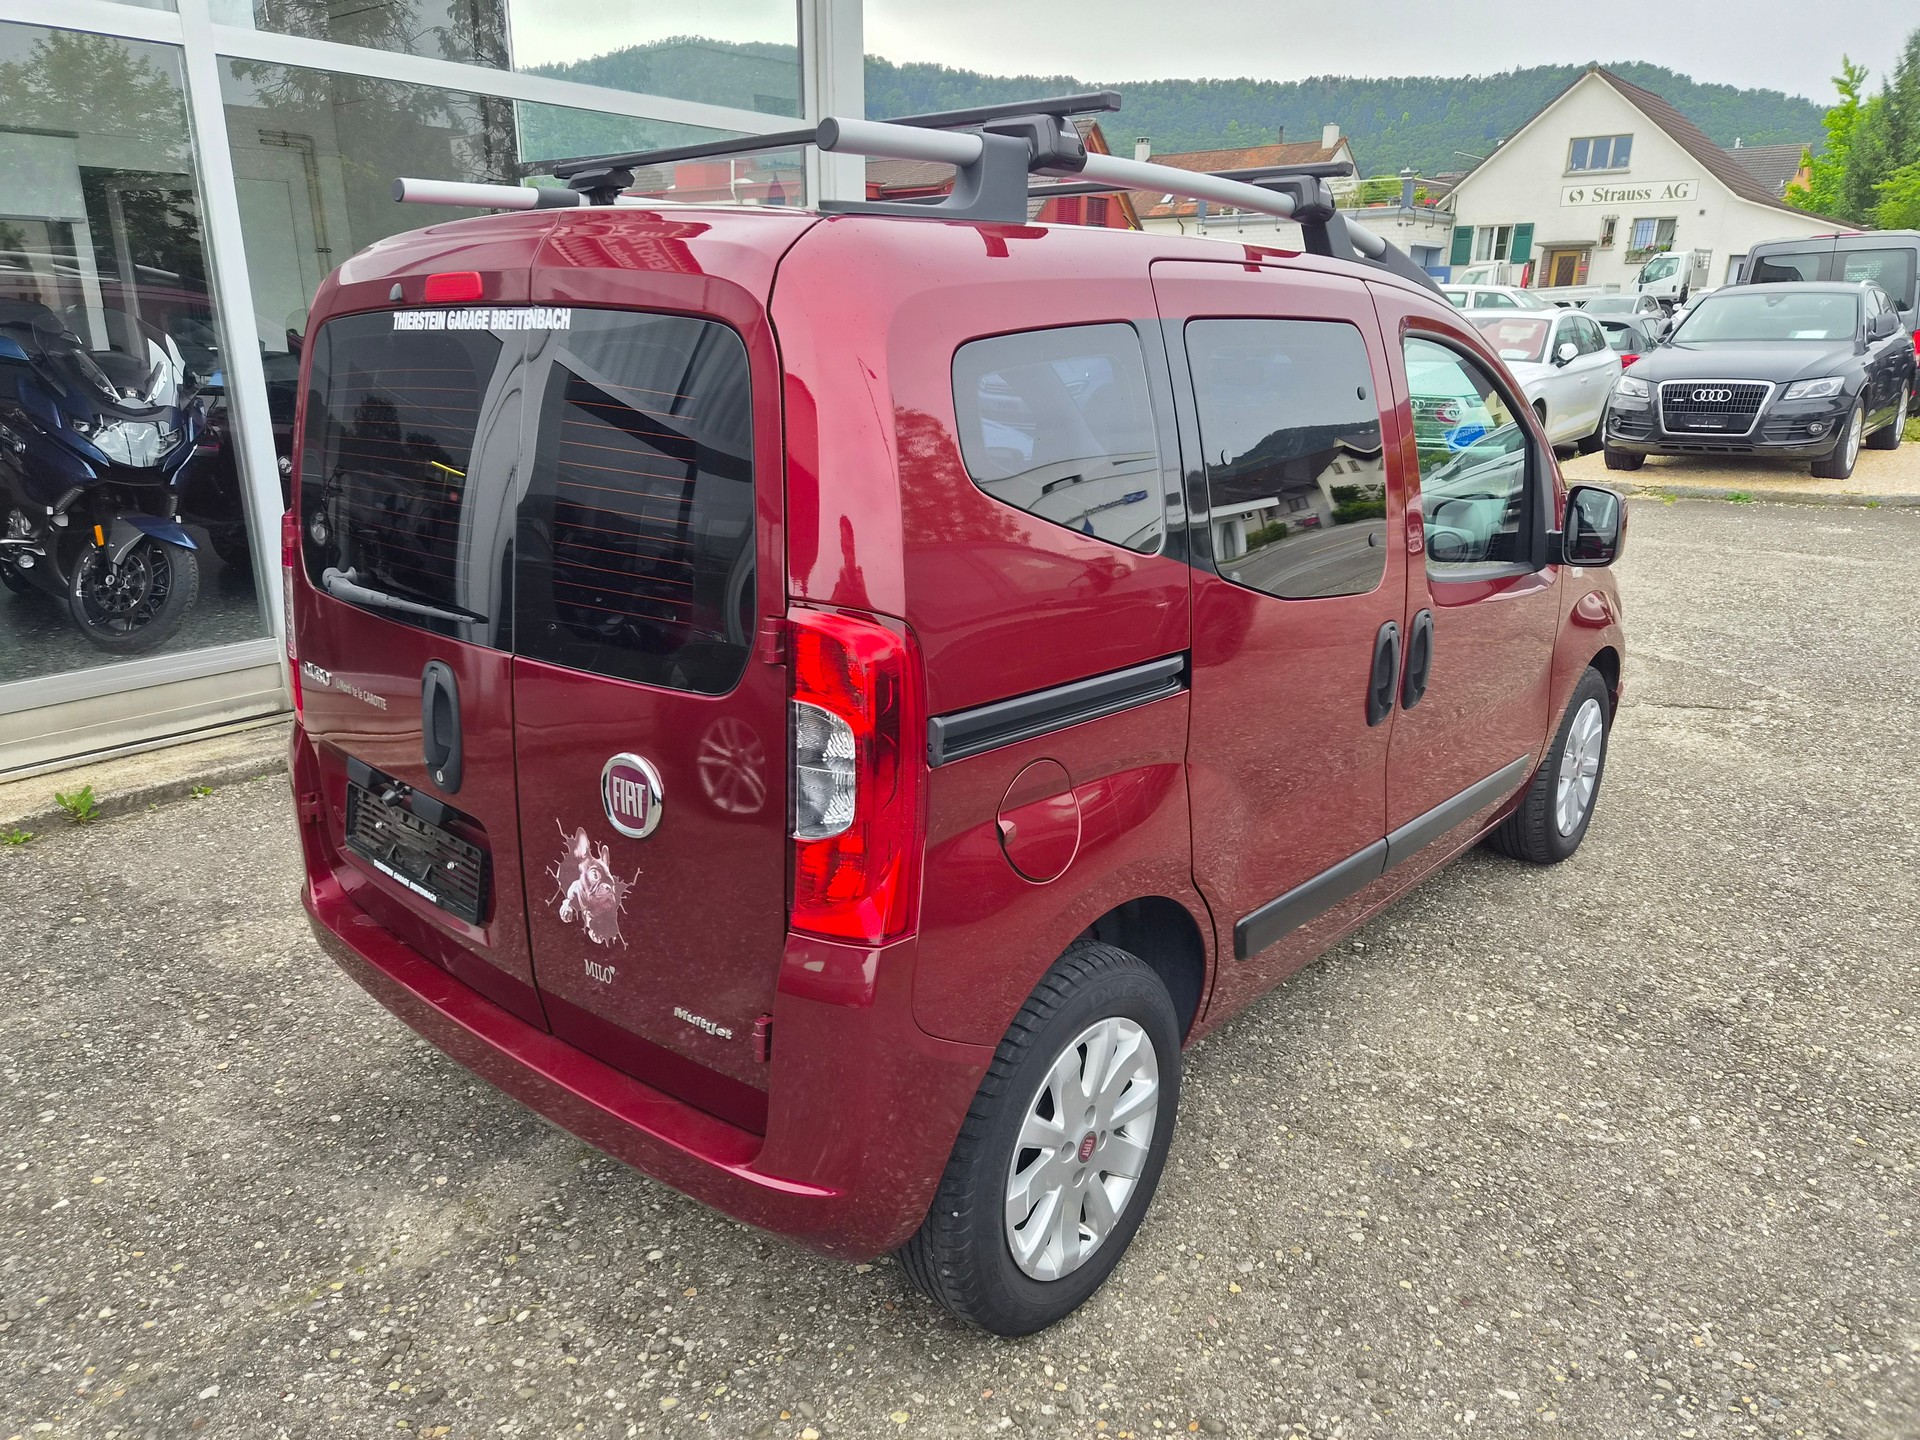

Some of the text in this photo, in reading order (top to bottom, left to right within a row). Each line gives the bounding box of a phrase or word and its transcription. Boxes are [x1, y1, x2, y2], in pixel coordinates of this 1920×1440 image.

[1592, 183, 1689, 203] Strauss AG
[393, 308, 572, 330] THIERSTEIN GARAGE BREITENBACH
[363, 691, 387, 711] CAROTTE
[612, 775, 646, 819] FIAT
[584, 958, 612, 984] MILO
[1081, 1139, 1093, 1157] FIAT
